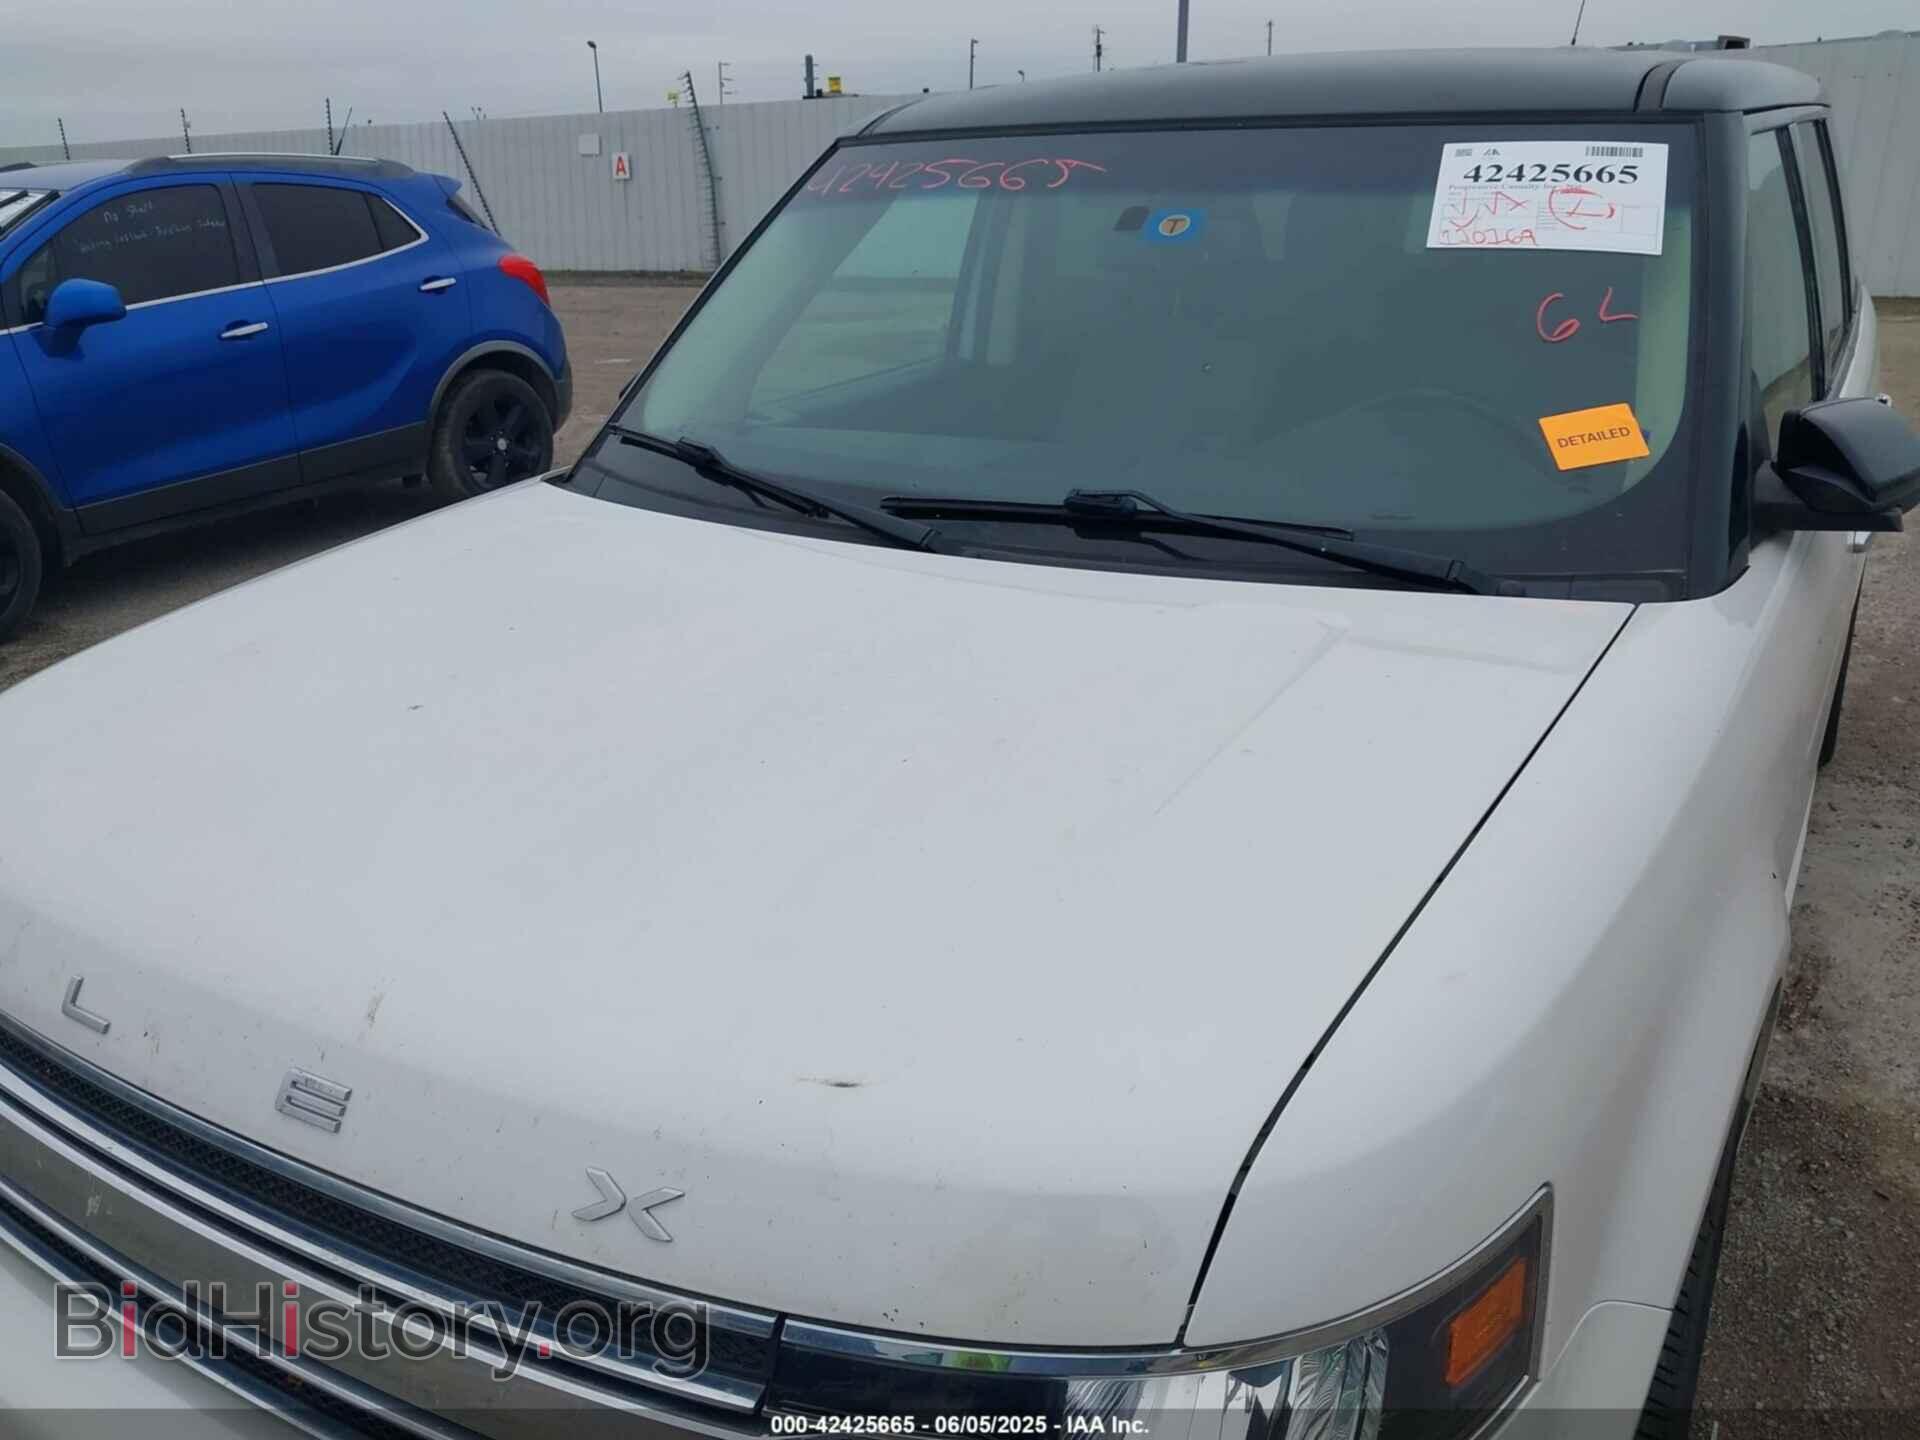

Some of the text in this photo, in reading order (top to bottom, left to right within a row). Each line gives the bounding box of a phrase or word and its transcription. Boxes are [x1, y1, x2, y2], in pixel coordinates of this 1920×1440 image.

[615, 156, 626, 176] A
[806, 158, 1107, 193] 42425665
[1463, 163, 1639, 185] 42425665
[1167, 218, 1186, 234] T
[1557, 426, 1631, 449] DETAILED
